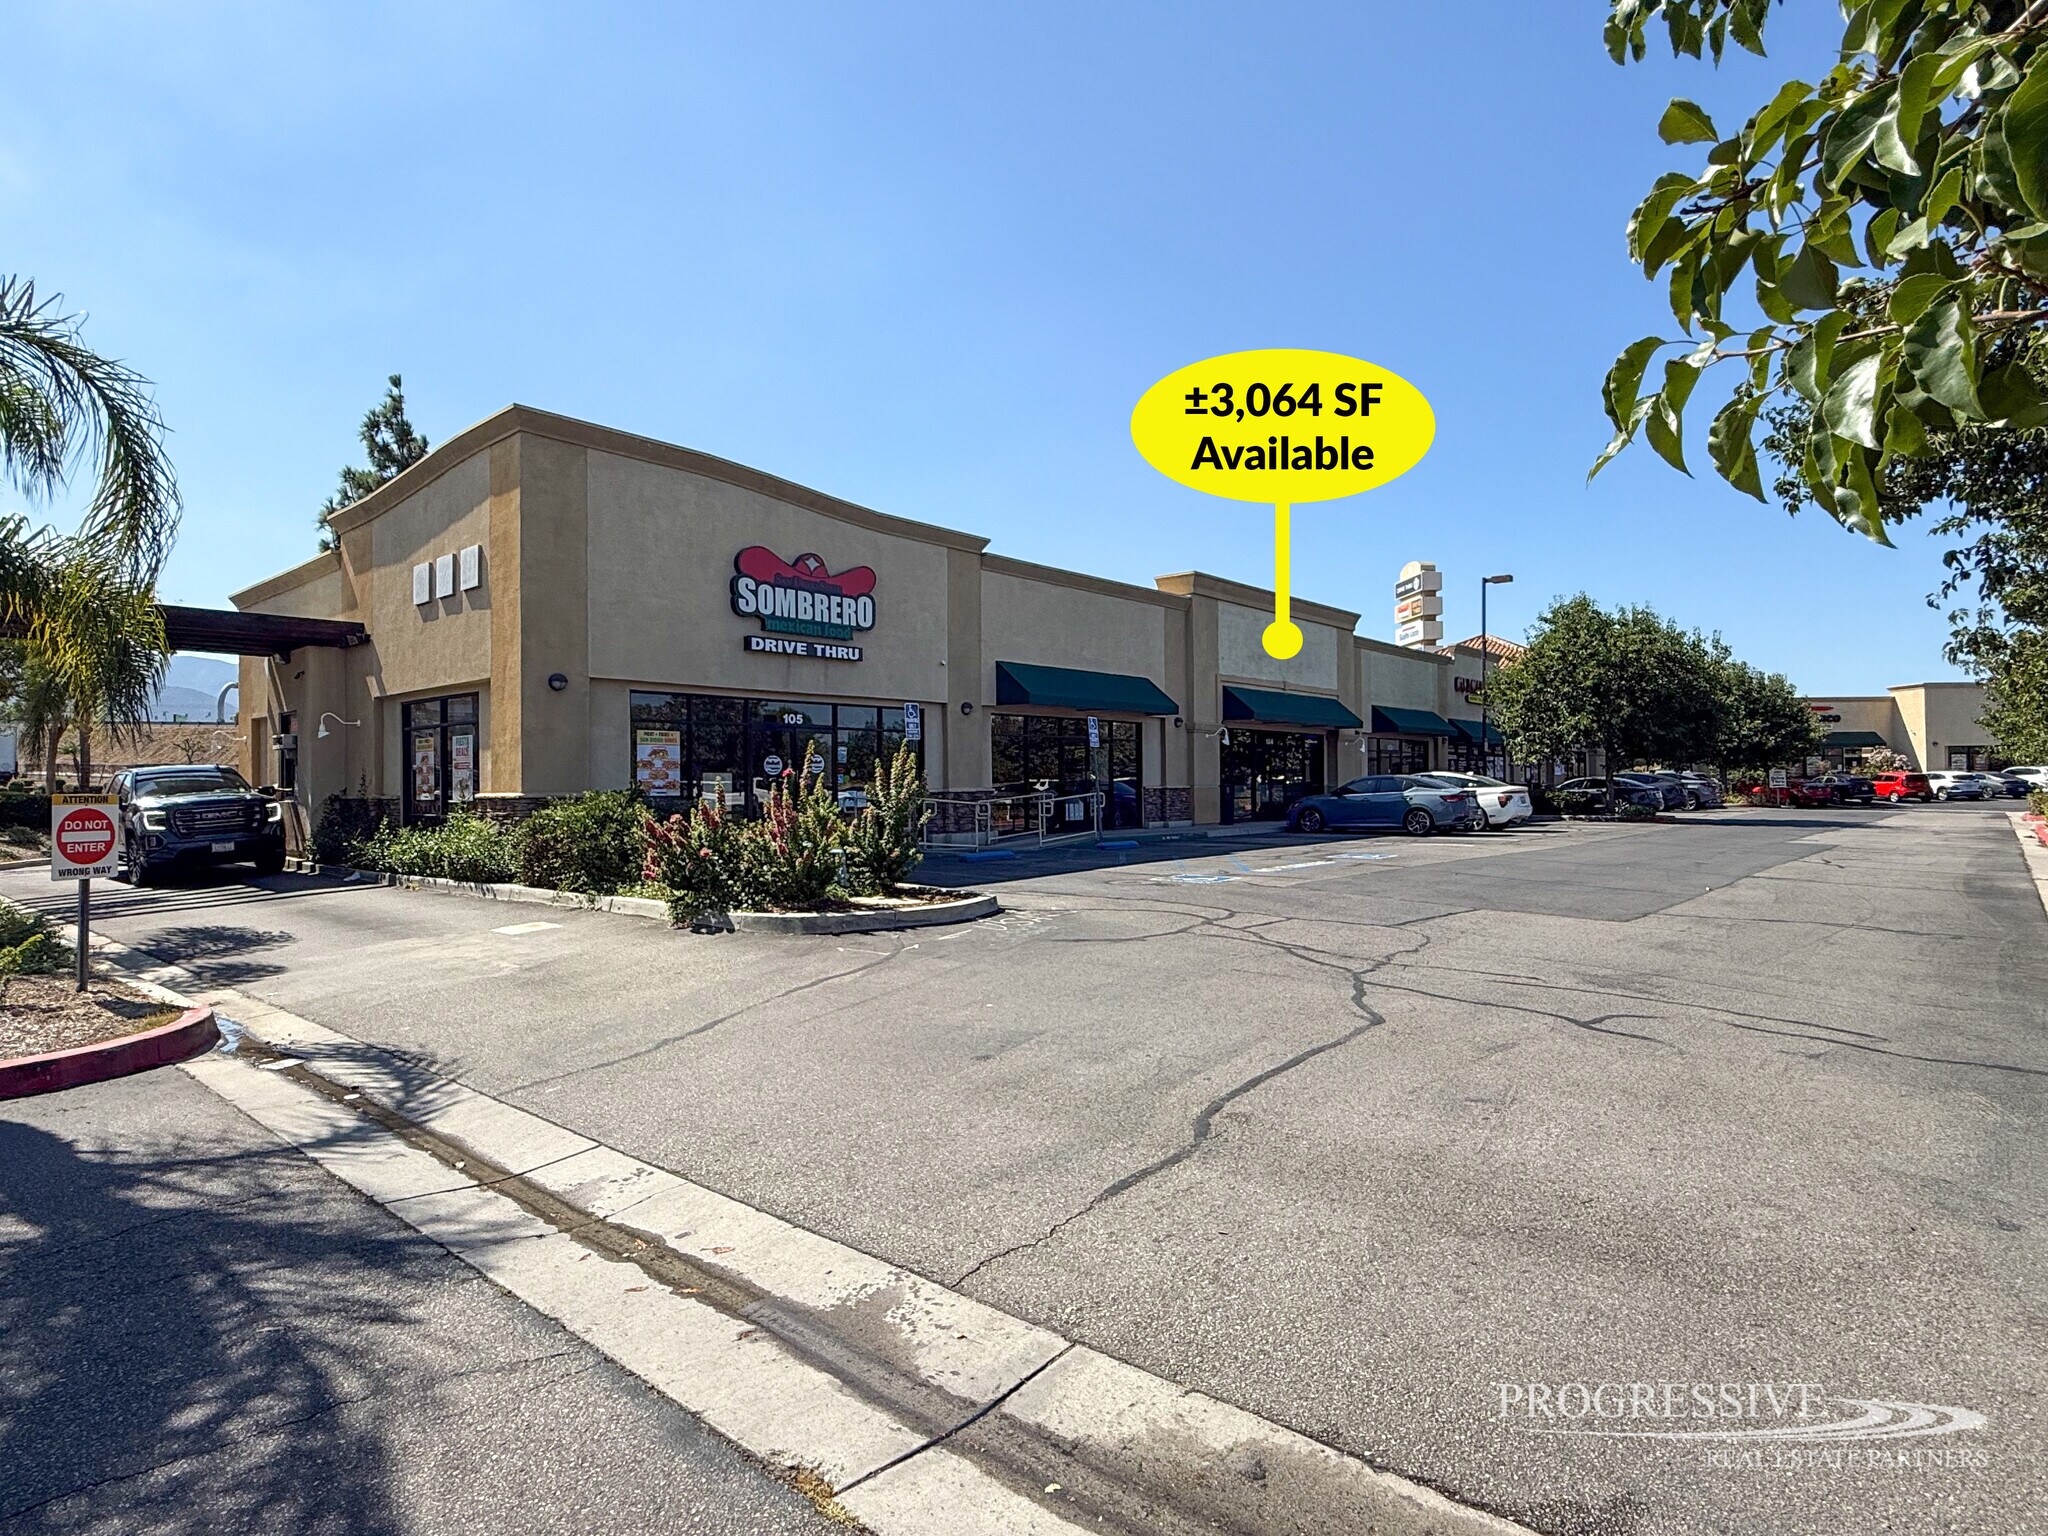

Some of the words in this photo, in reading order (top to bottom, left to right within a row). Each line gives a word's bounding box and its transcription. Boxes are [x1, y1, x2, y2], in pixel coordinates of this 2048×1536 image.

[737, 577, 873, 629] SOMBRERO
[767, 618, 822, 637] mexican
[824, 623, 850, 639] food
[751, 637, 808, 656] DRIVE
[813, 644, 860, 660] THRU
[783, 713, 803, 725] 105
[62, 795, 109, 804] ATTENTION
[201, 811, 238, 819] GMC
[64, 821, 82, 830] DO
[85, 820, 109, 829] NOT
[66, 842, 106, 853] ENTER
[58, 867, 91, 877] WRONG
[92, 866, 112, 875] WAY
